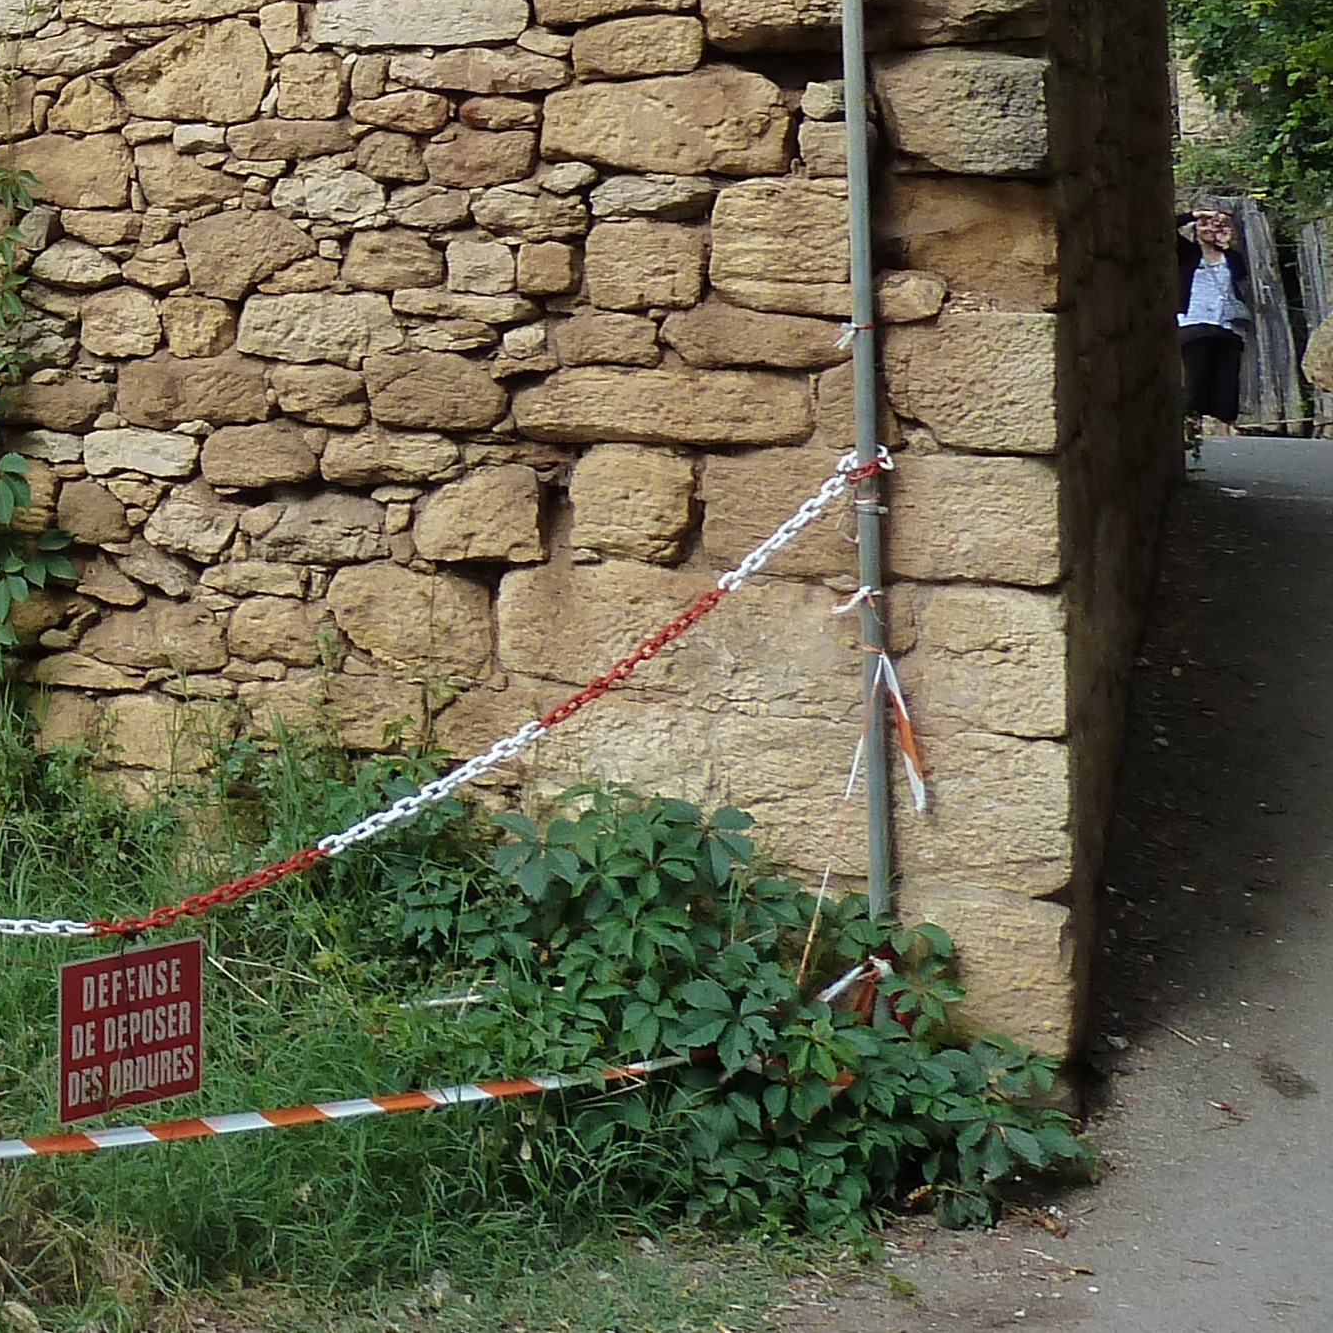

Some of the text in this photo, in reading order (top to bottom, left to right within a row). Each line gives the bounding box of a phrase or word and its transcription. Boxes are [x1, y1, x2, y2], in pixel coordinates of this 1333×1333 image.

[82, 958, 181, 1012] DEFENSE
[71, 1001, 191, 1060] DE DEPOSER
[68, 1044, 194, 1107] DES ORDURES
